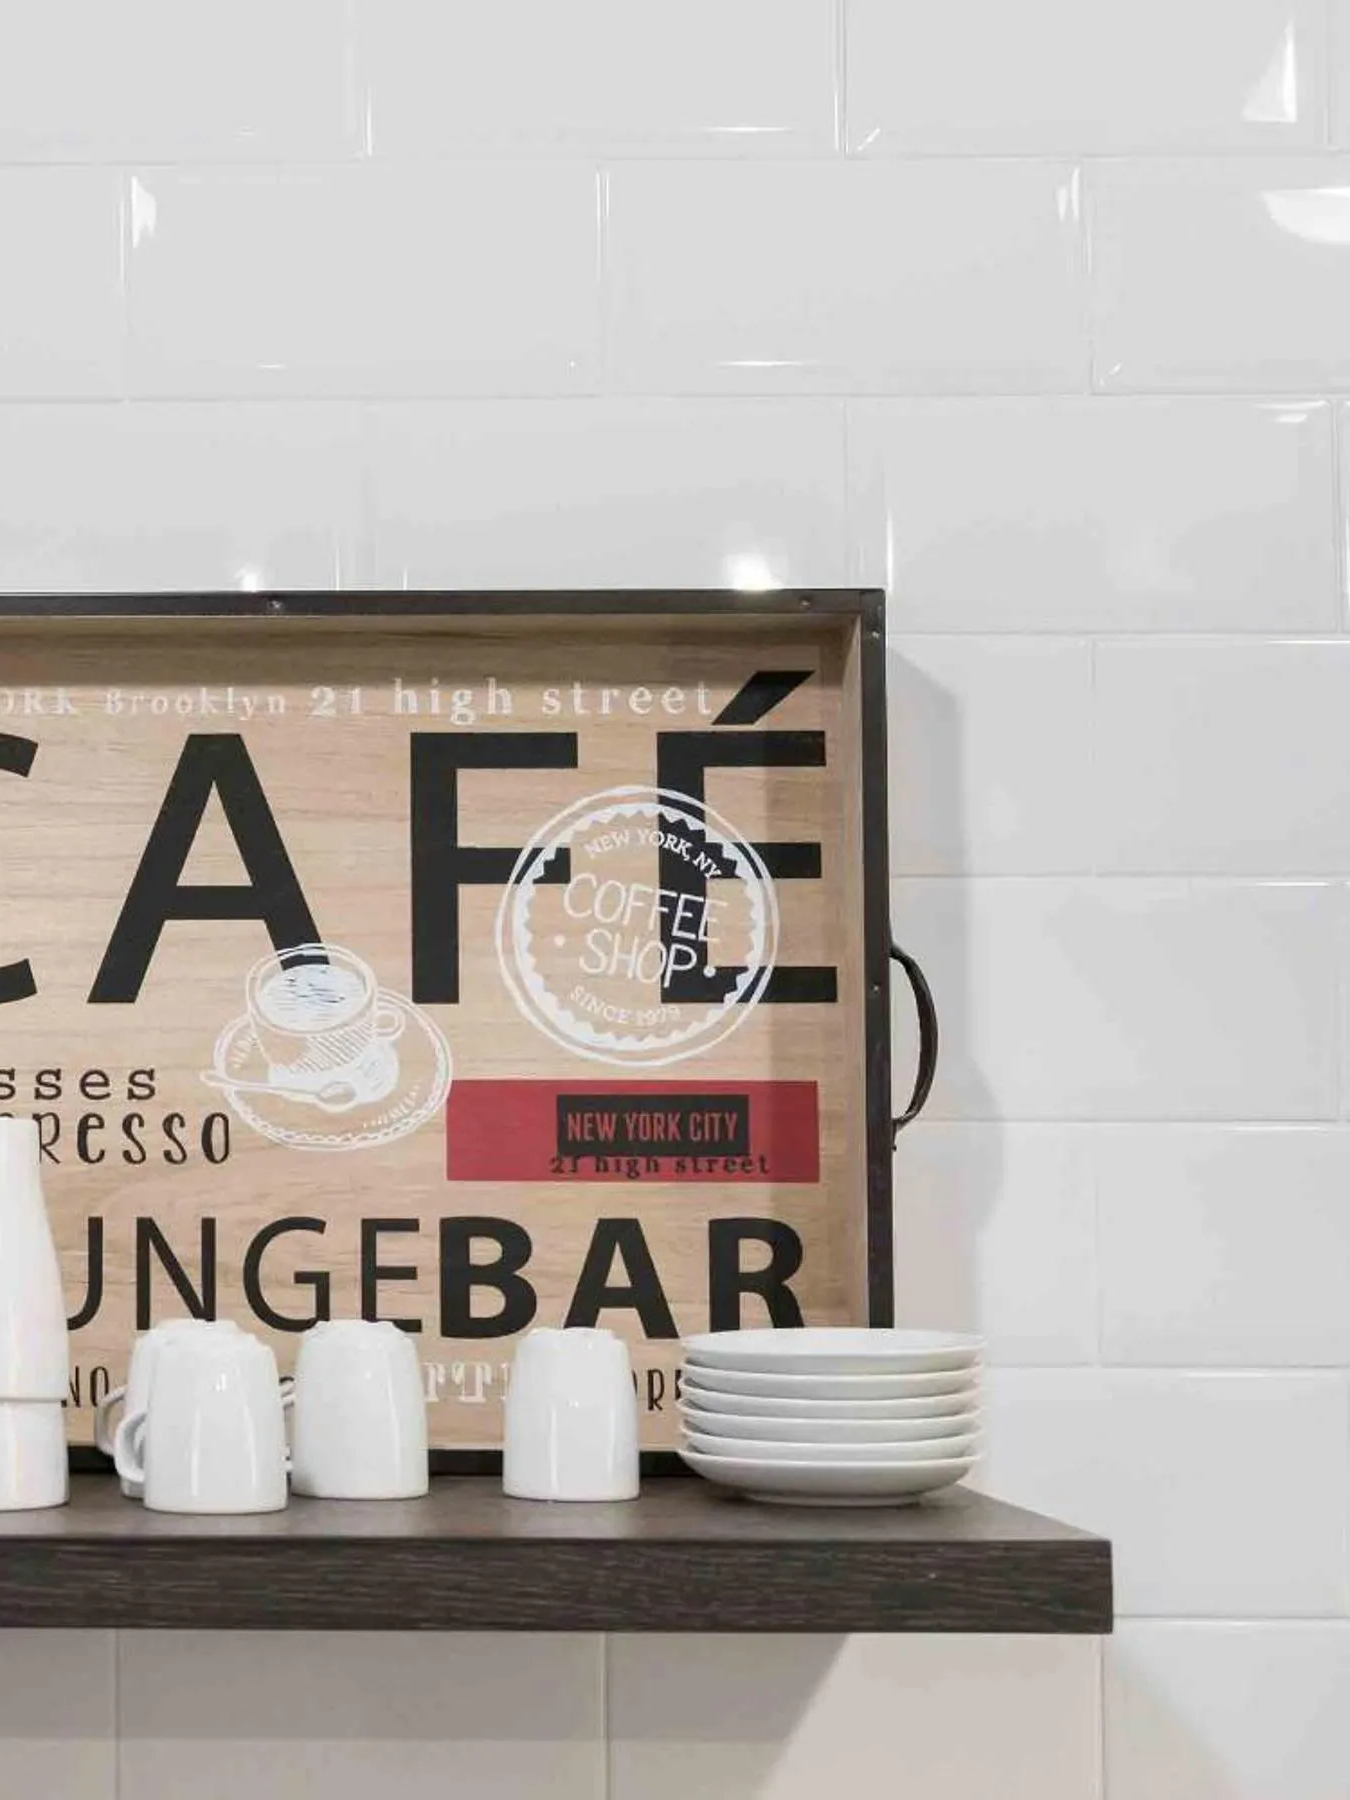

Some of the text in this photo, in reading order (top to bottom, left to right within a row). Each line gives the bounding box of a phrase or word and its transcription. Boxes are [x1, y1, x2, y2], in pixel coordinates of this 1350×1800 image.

[105, 686, 287, 722] Brooklyn
[310, 682, 363, 717] 21
[394, 676, 514, 726] high
[541, 680, 712, 716] street
[584, 829, 630, 860] NEW
[692, 851, 723, 879] NY
[563, 872, 730, 943] COFFEE
[578, 927, 699, 989] SHOP
[569, 985, 632, 1025] SINCE
[566, 1111, 739, 1143] NEW YORK CITY
[594, 1153, 660, 1180] high
[673, 1153, 772, 1175] street
